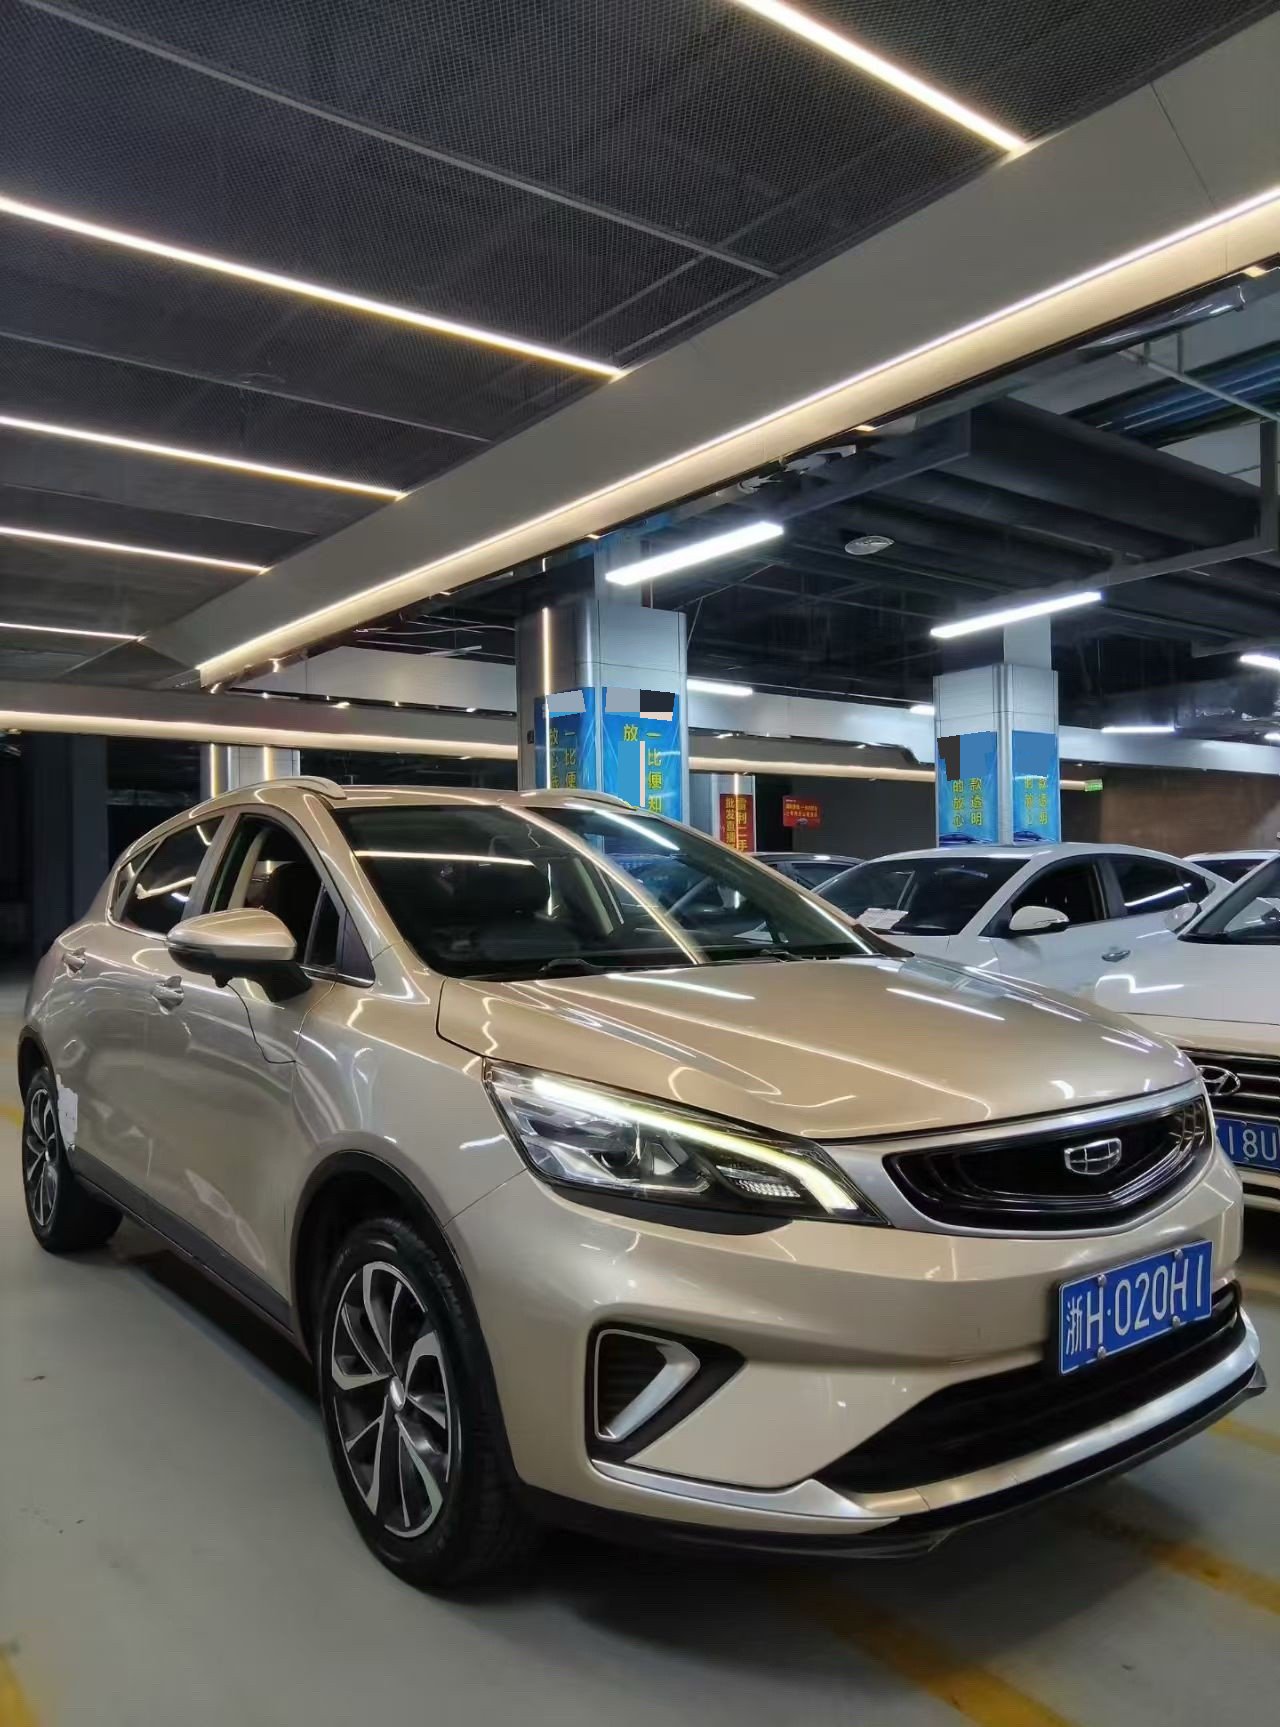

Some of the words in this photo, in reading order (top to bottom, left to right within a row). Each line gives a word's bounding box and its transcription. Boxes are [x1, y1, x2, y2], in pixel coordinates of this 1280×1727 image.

[646, 731, 662, 812] 一比便知
[1215, 1125, 1278, 1161] 18U
